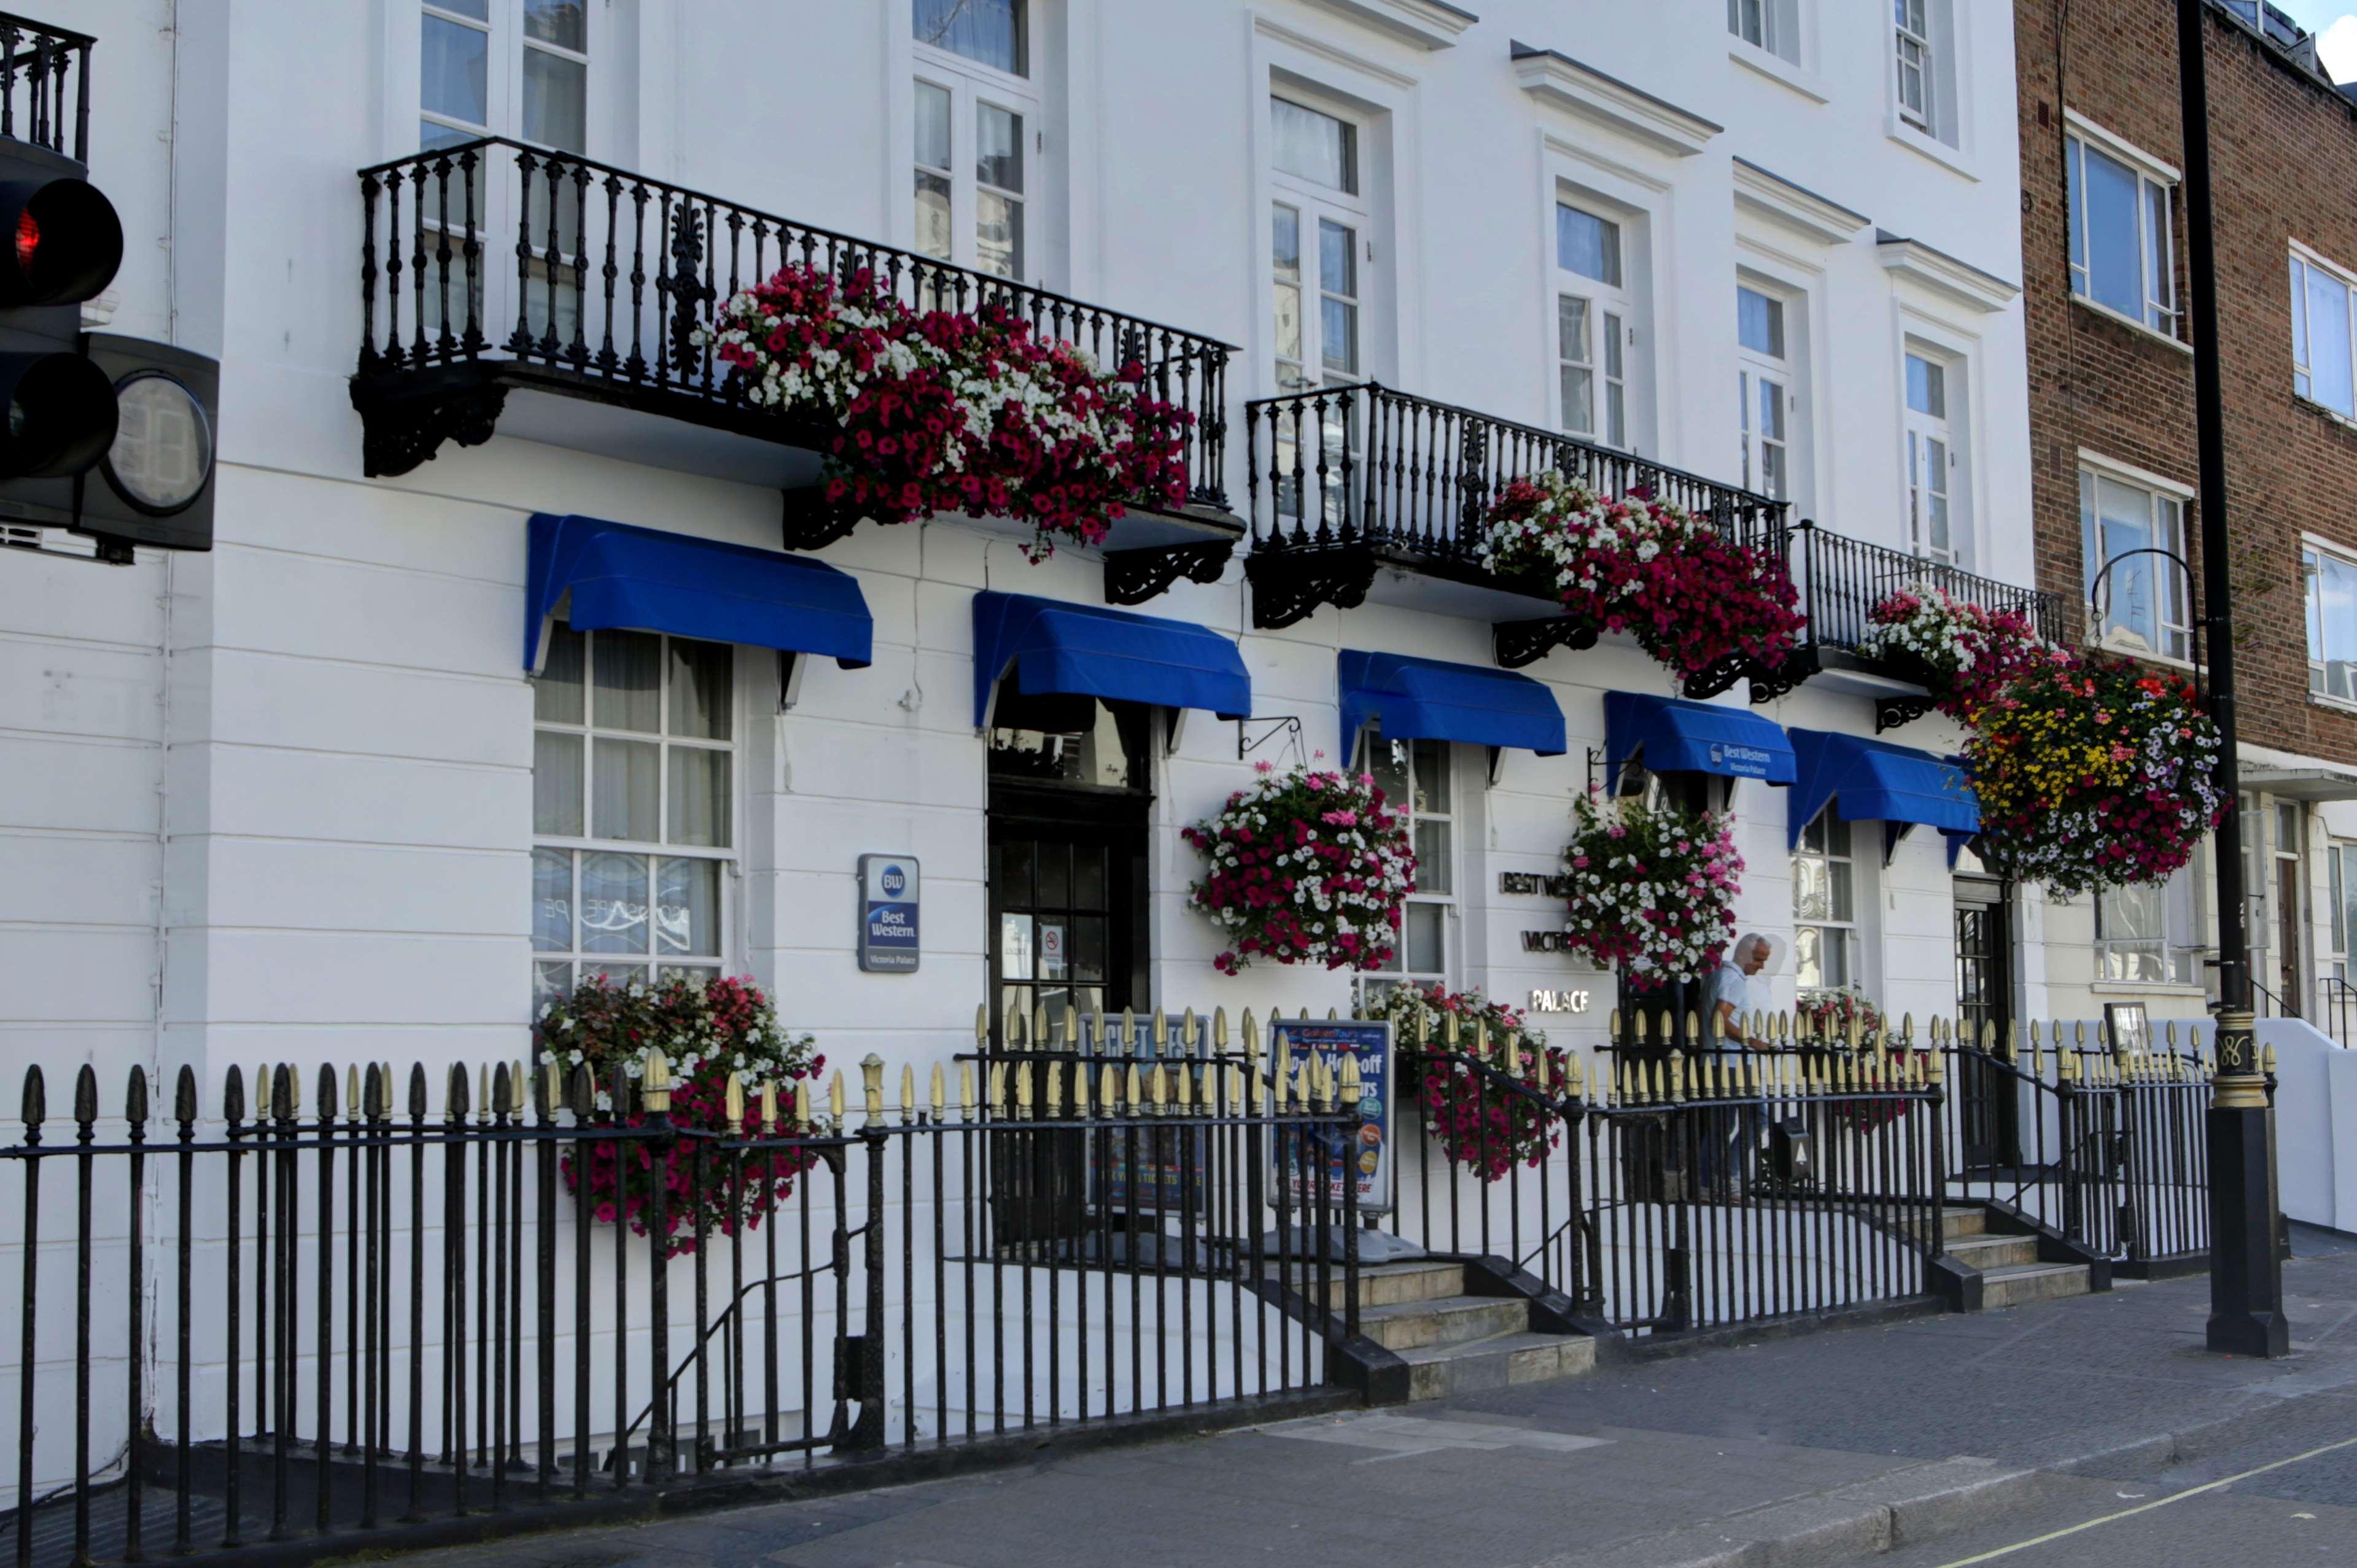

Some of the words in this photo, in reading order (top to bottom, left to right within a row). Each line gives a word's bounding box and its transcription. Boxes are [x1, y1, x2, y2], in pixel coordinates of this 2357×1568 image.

[1723, 745, 1740, 759] Best
[1740, 747, 1771, 763] Western
[883, 874, 903, 889] BW
[1499, 872, 1537, 895] BEST
[882, 910, 906, 925] Best
[871, 923, 914, 937] Western
[870, 955, 895, 965] Victoria
[895, 955, 917, 965] Palace
[1529, 990, 1589, 1013] PALACE
[1089, 1025, 1149, 1058] TCKT
[1162, 1027, 1202, 1058] ESK
[1326, 1053, 1383, 1074] Ho-off
[1144, 1173, 1178, 1185] TICETS
